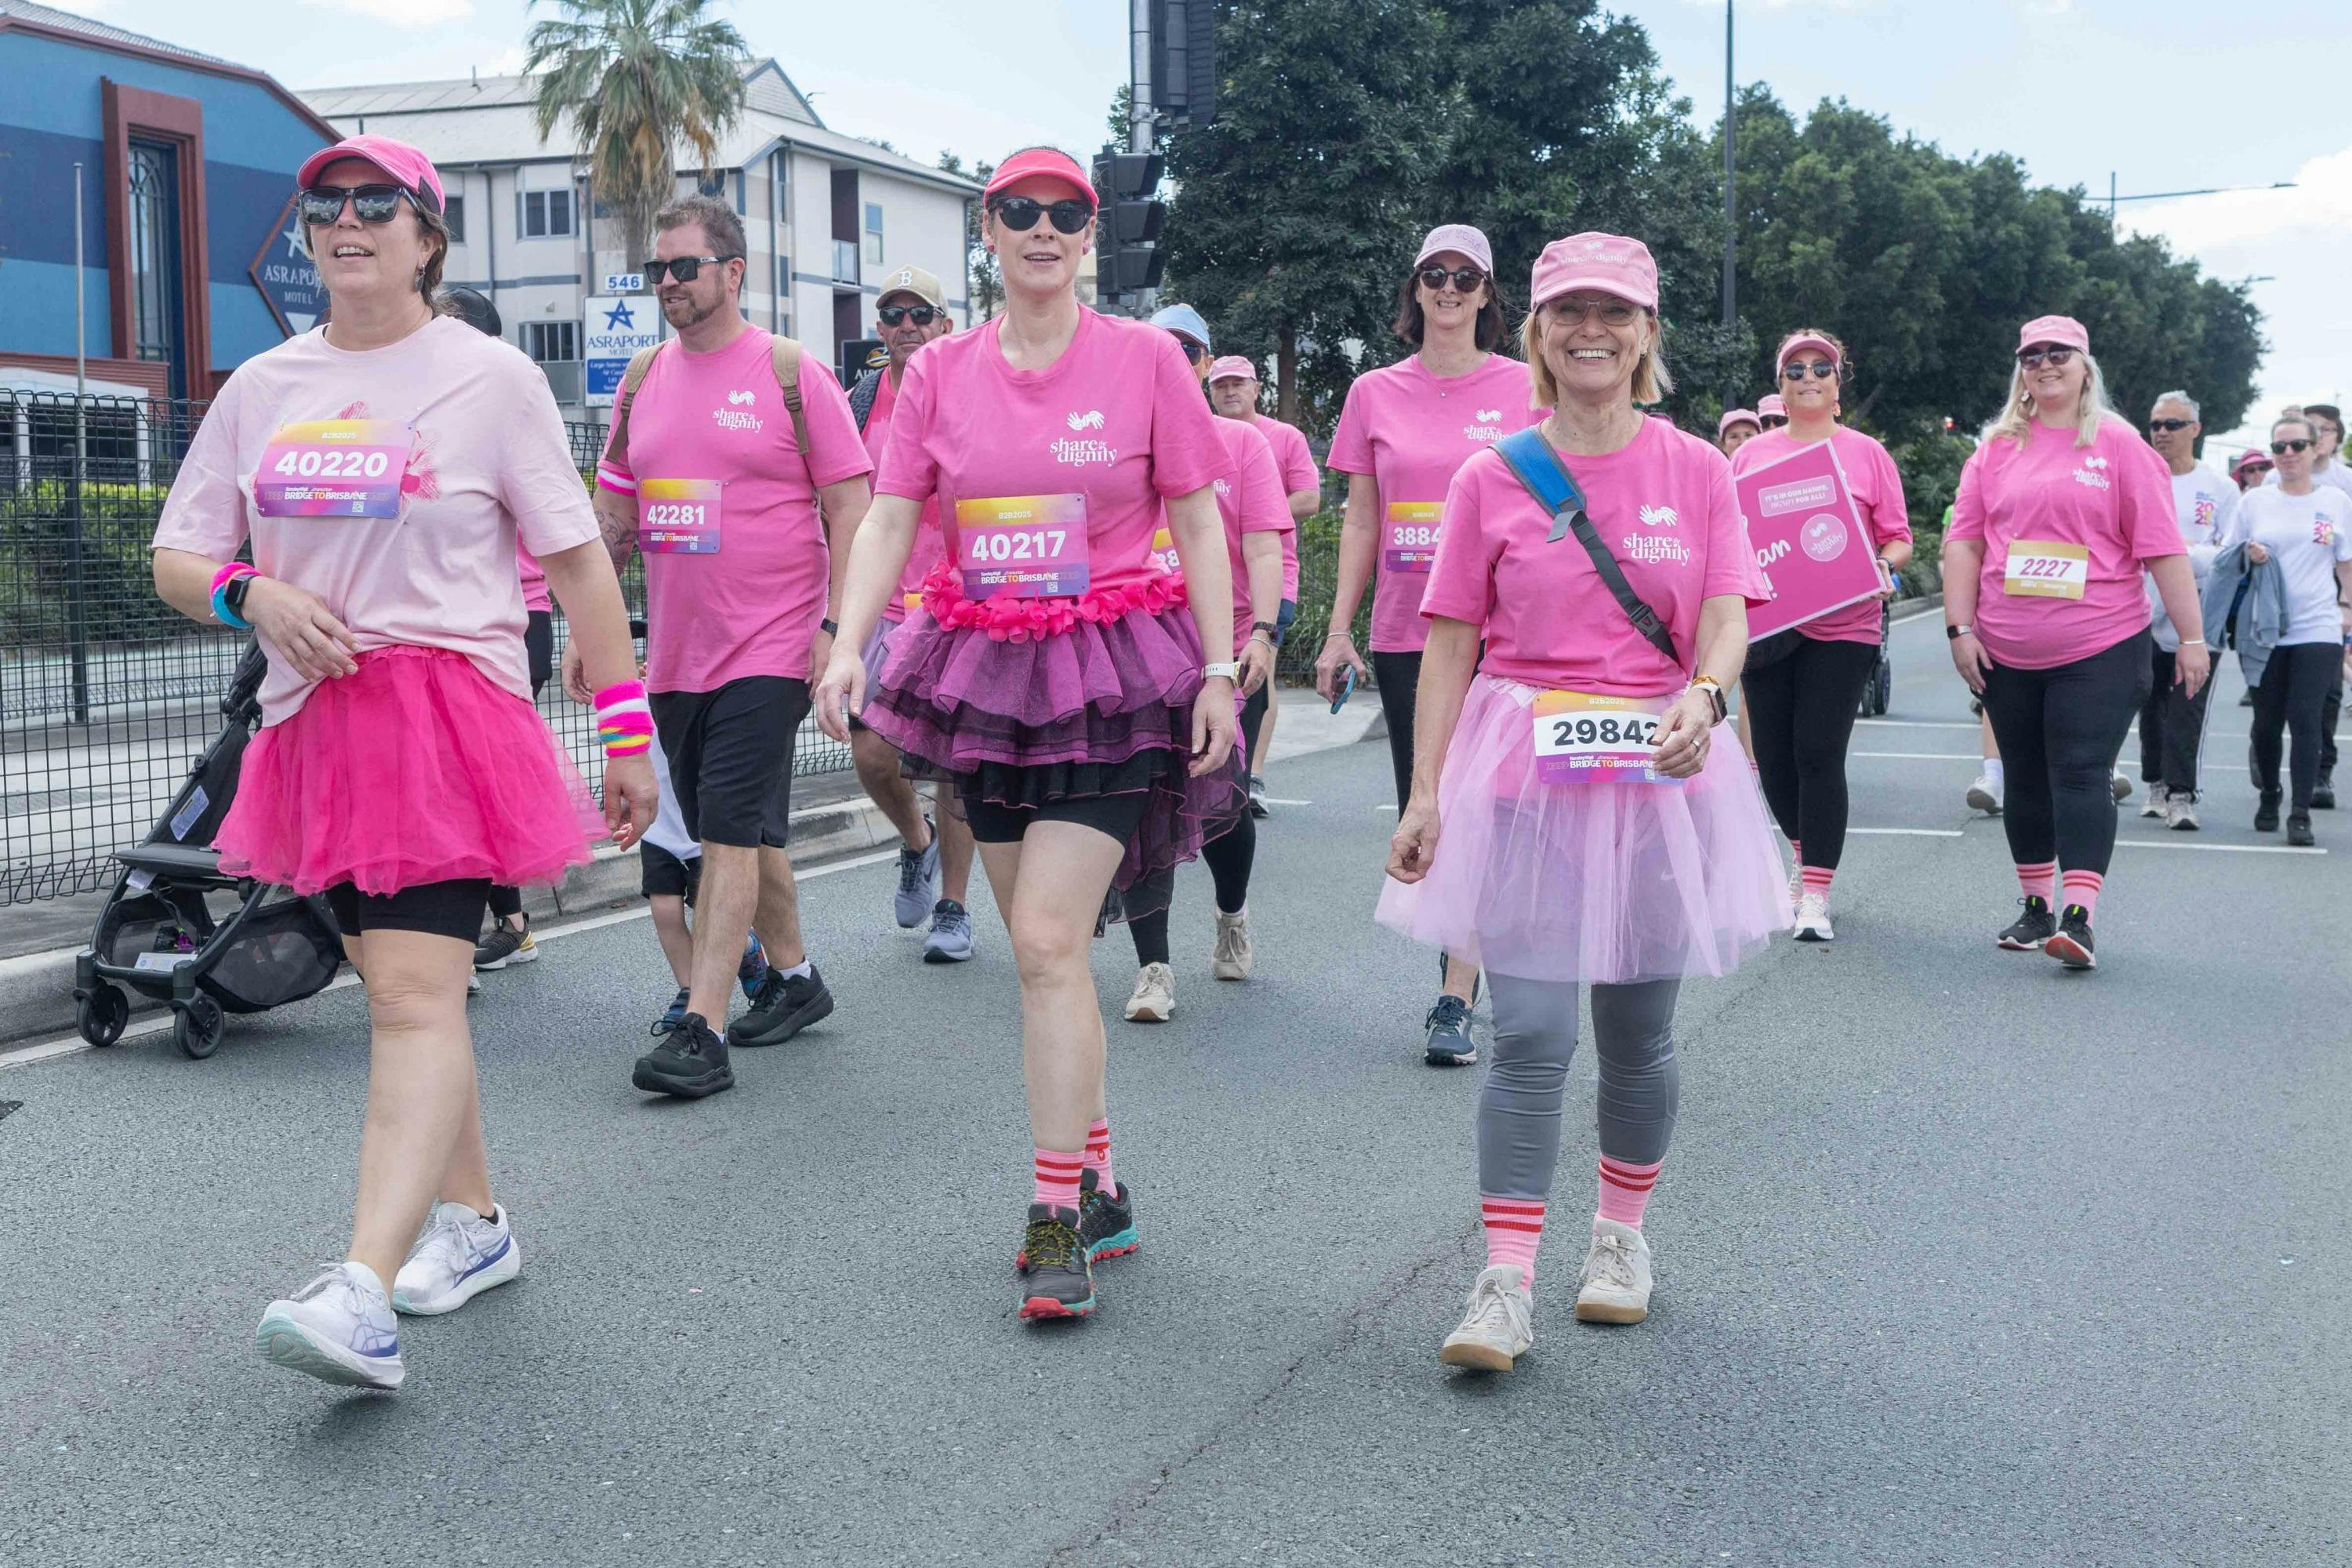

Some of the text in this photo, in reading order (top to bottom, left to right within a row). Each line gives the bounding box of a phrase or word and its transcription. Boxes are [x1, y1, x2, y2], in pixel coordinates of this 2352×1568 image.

[1595, 252, 1626, 265] dignity
[608, 276, 640, 289] 546
[898, 270, 913, 287] B
[284, 291, 313, 304] MOTEL
[587, 335, 659, 348] ASRAPORT
[713, 408, 749, 419] share
[718, 415, 763, 433] dignity
[1050, 437, 1098, 453] share
[274, 451, 388, 477] 40220
[1057, 446, 1117, 467] dignity
[285, 492, 314, 500] BRIDGE
[325, 492, 368, 500] BRISBANE
[647, 505, 704, 524] 42281
[998, 510, 1032, 519] B2B2025
[971, 530, 1066, 561] 40217
[1623, 532, 1672, 549] share
[1631, 544, 1690, 566] dignity
[2020, 558, 2072, 577] 2227
[981, 572, 1059, 584] BRIDGE TO BRISBANE
[1553, 718, 1663, 746] 29842
